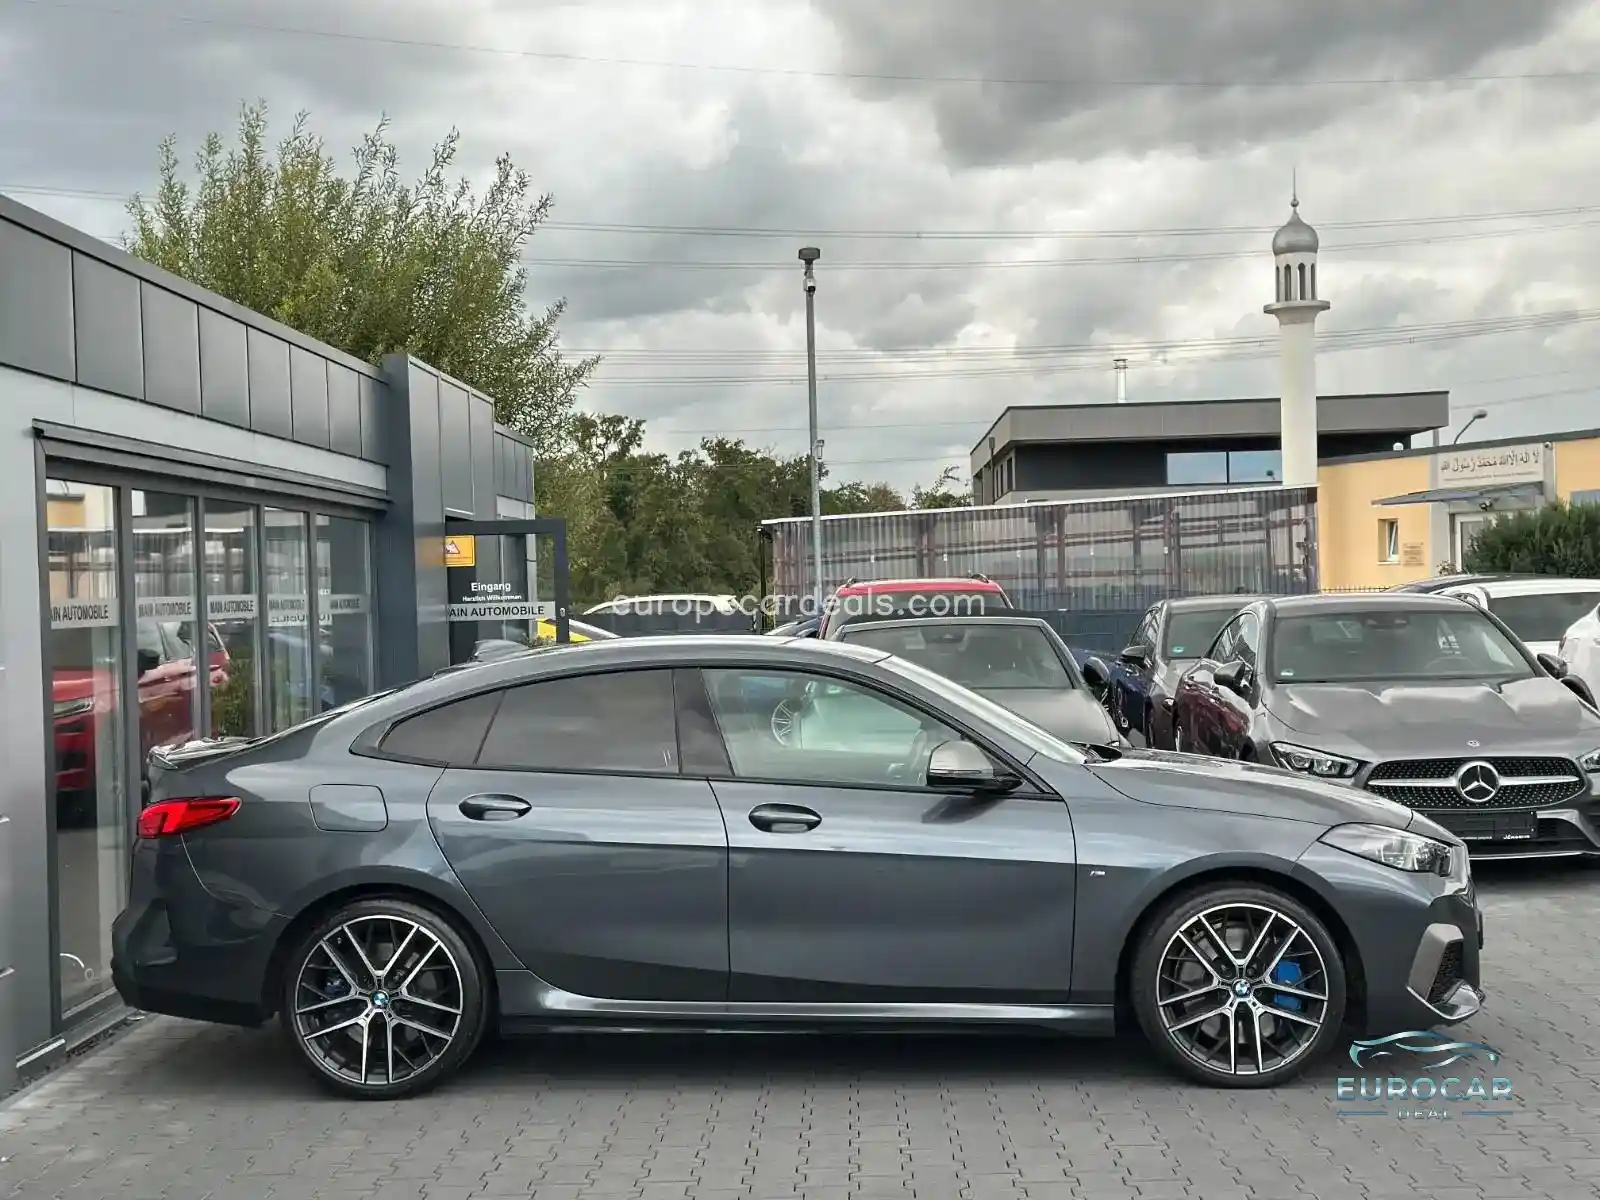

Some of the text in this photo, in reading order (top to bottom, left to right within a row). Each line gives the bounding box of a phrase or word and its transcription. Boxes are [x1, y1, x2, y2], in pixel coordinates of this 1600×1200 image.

[471, 582, 511, 593] Eingang
[62, 604, 109, 621] AUTOMOBILE
[470, 605, 545, 616] AUTOMOBILE
